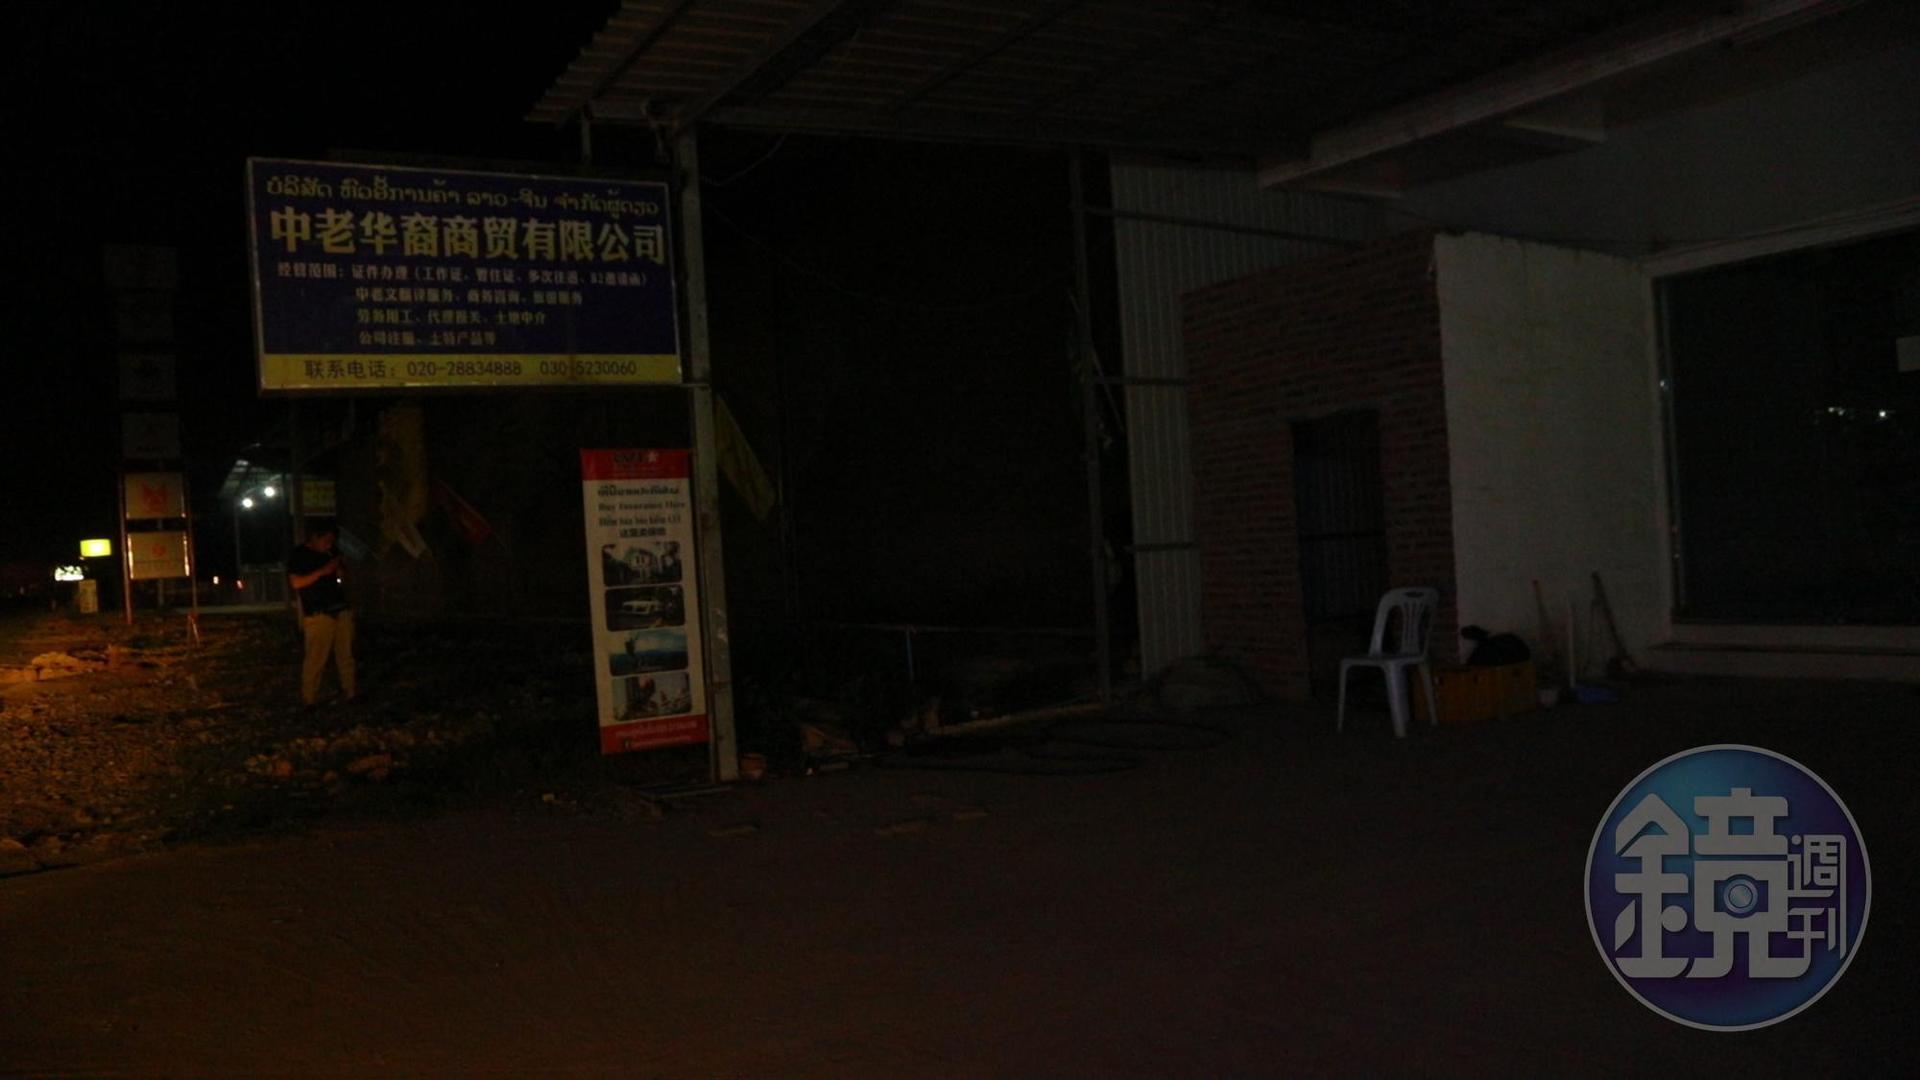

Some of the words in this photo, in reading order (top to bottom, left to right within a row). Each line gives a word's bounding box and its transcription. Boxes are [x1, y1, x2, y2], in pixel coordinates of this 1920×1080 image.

[269, 205, 665, 265] 中老华裔商贸有限公司
[406, 360, 522, 377] 020-28834888
[539, 360, 637, 376] 030-5230060
